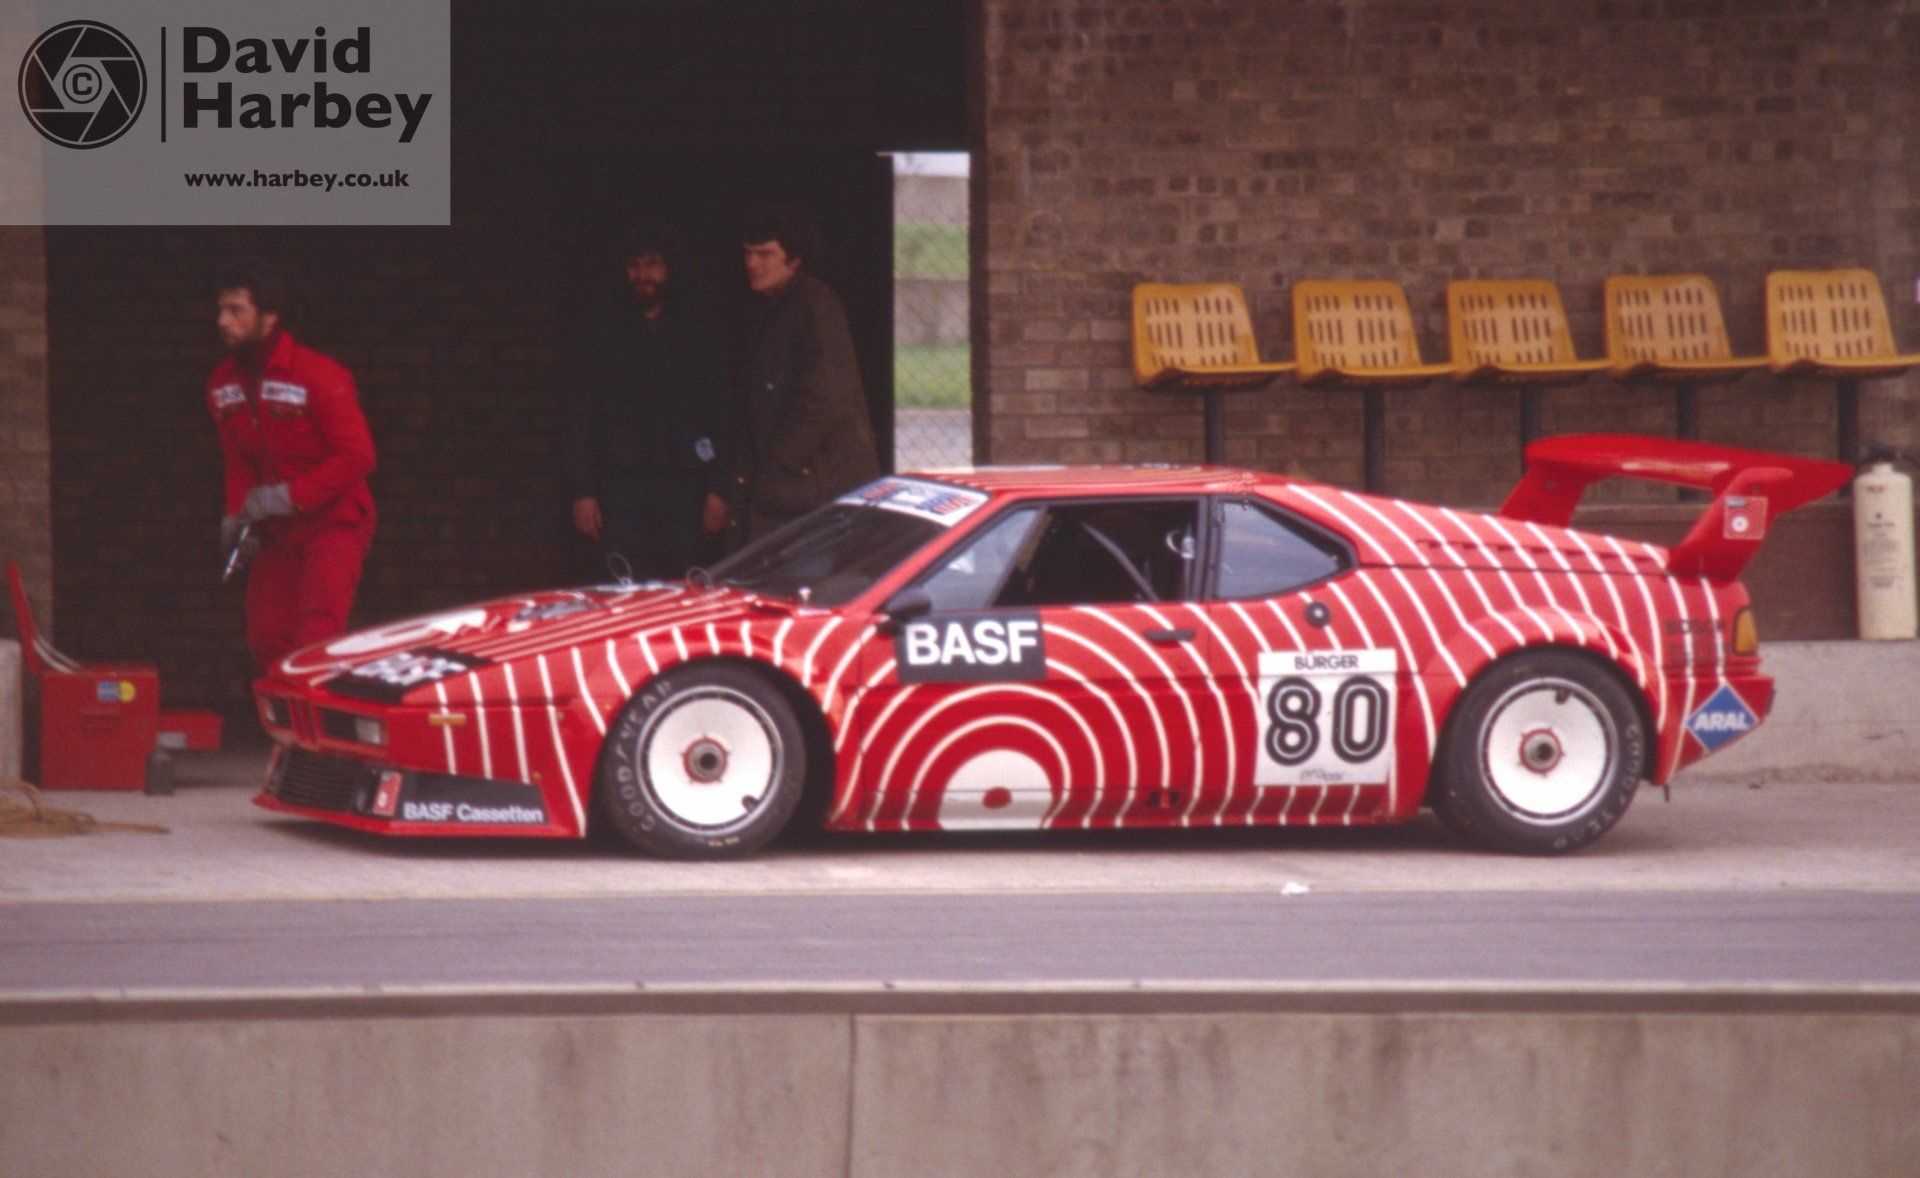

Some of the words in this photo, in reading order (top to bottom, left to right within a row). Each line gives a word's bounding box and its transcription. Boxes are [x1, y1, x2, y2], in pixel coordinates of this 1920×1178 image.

[906, 620, 1038, 665] BASF
[1265, 674, 1389, 767] 80
[1693, 711, 1749, 731] ARAL
[403, 802, 453, 821] BASF
[456, 804, 544, 823] Cassetten
